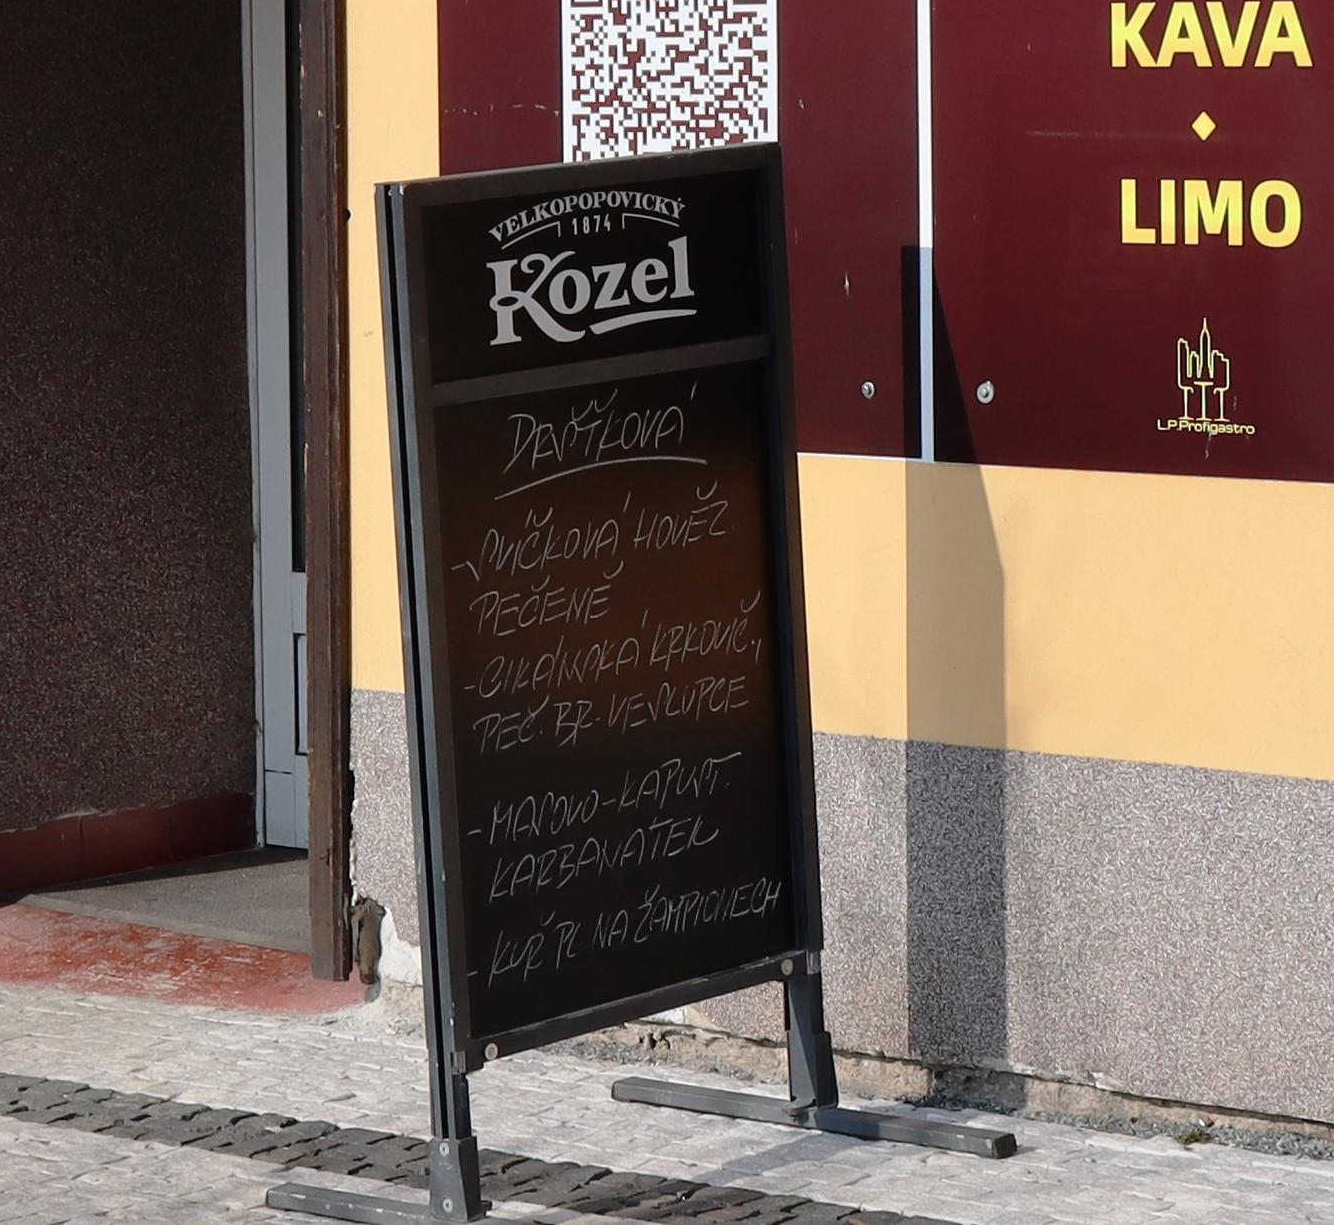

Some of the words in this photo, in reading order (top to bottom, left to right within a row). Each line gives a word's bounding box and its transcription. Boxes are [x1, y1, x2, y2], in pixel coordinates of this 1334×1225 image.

[487, 190, 686, 243] VELKOPOPOVICKÝ
[571, 213, 612, 235] 1874
[1122, 179, 1301, 247] LIMO
[485, 235, 695, 346] Kozel
[591, 909, 629, 950] NA
